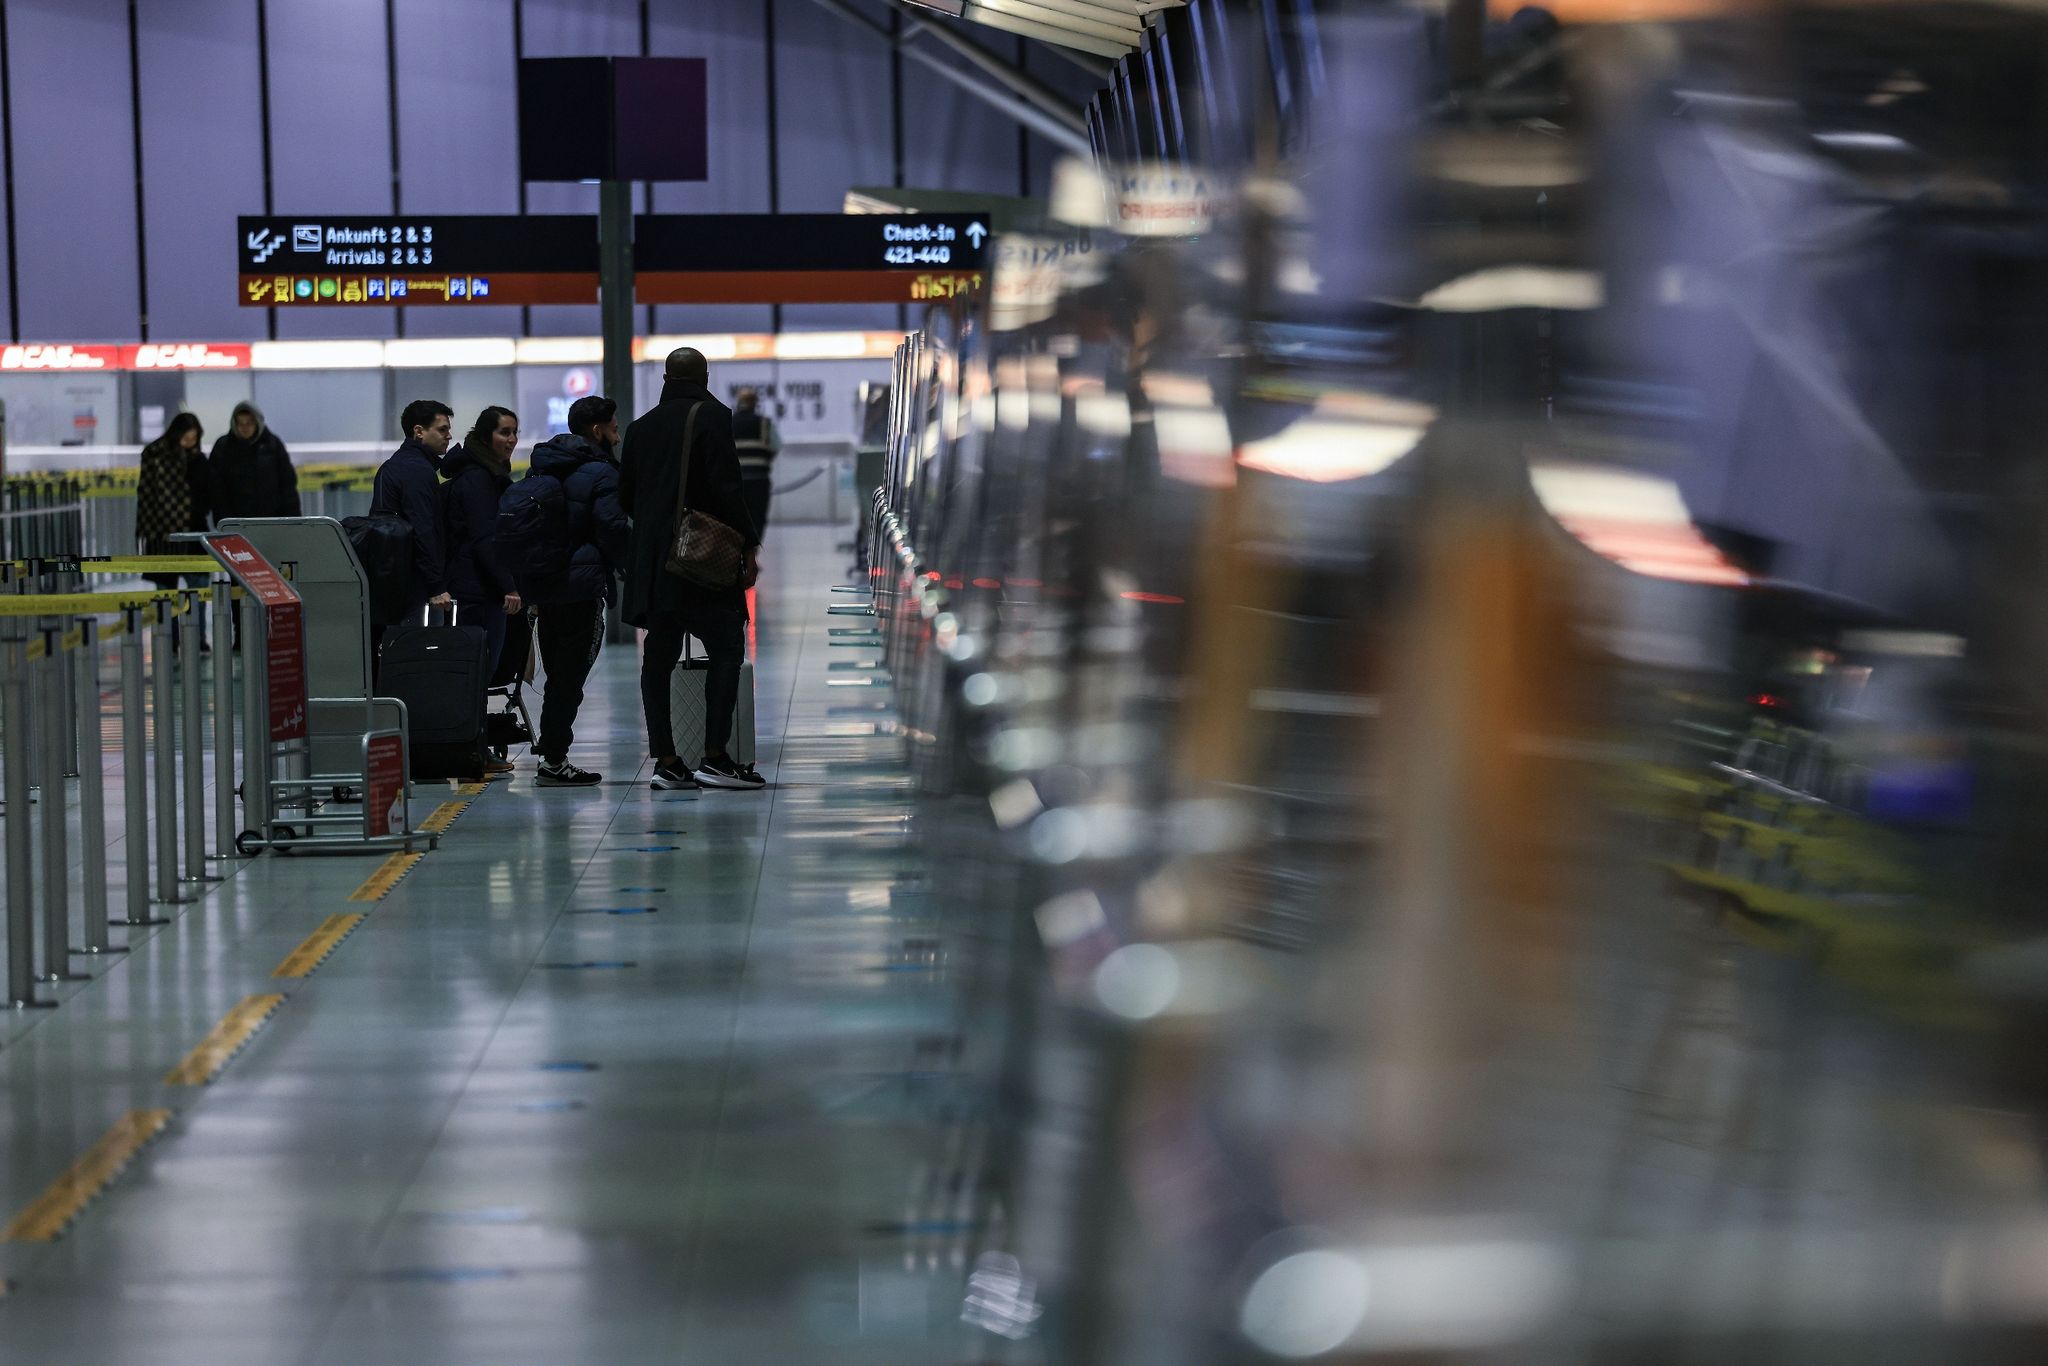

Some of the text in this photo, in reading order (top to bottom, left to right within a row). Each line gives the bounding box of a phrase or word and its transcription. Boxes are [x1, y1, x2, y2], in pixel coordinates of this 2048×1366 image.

[326, 226, 433, 243] Ankunft 2 & 3
[883, 223, 957, 242] Check-in
[326, 247, 433, 265] Arrivals 2 & 3
[884, 245, 951, 264] 421-440
[368, 279, 385, 297] P1
[390, 279, 407, 297] P2
[449, 279, 466, 297] P3
